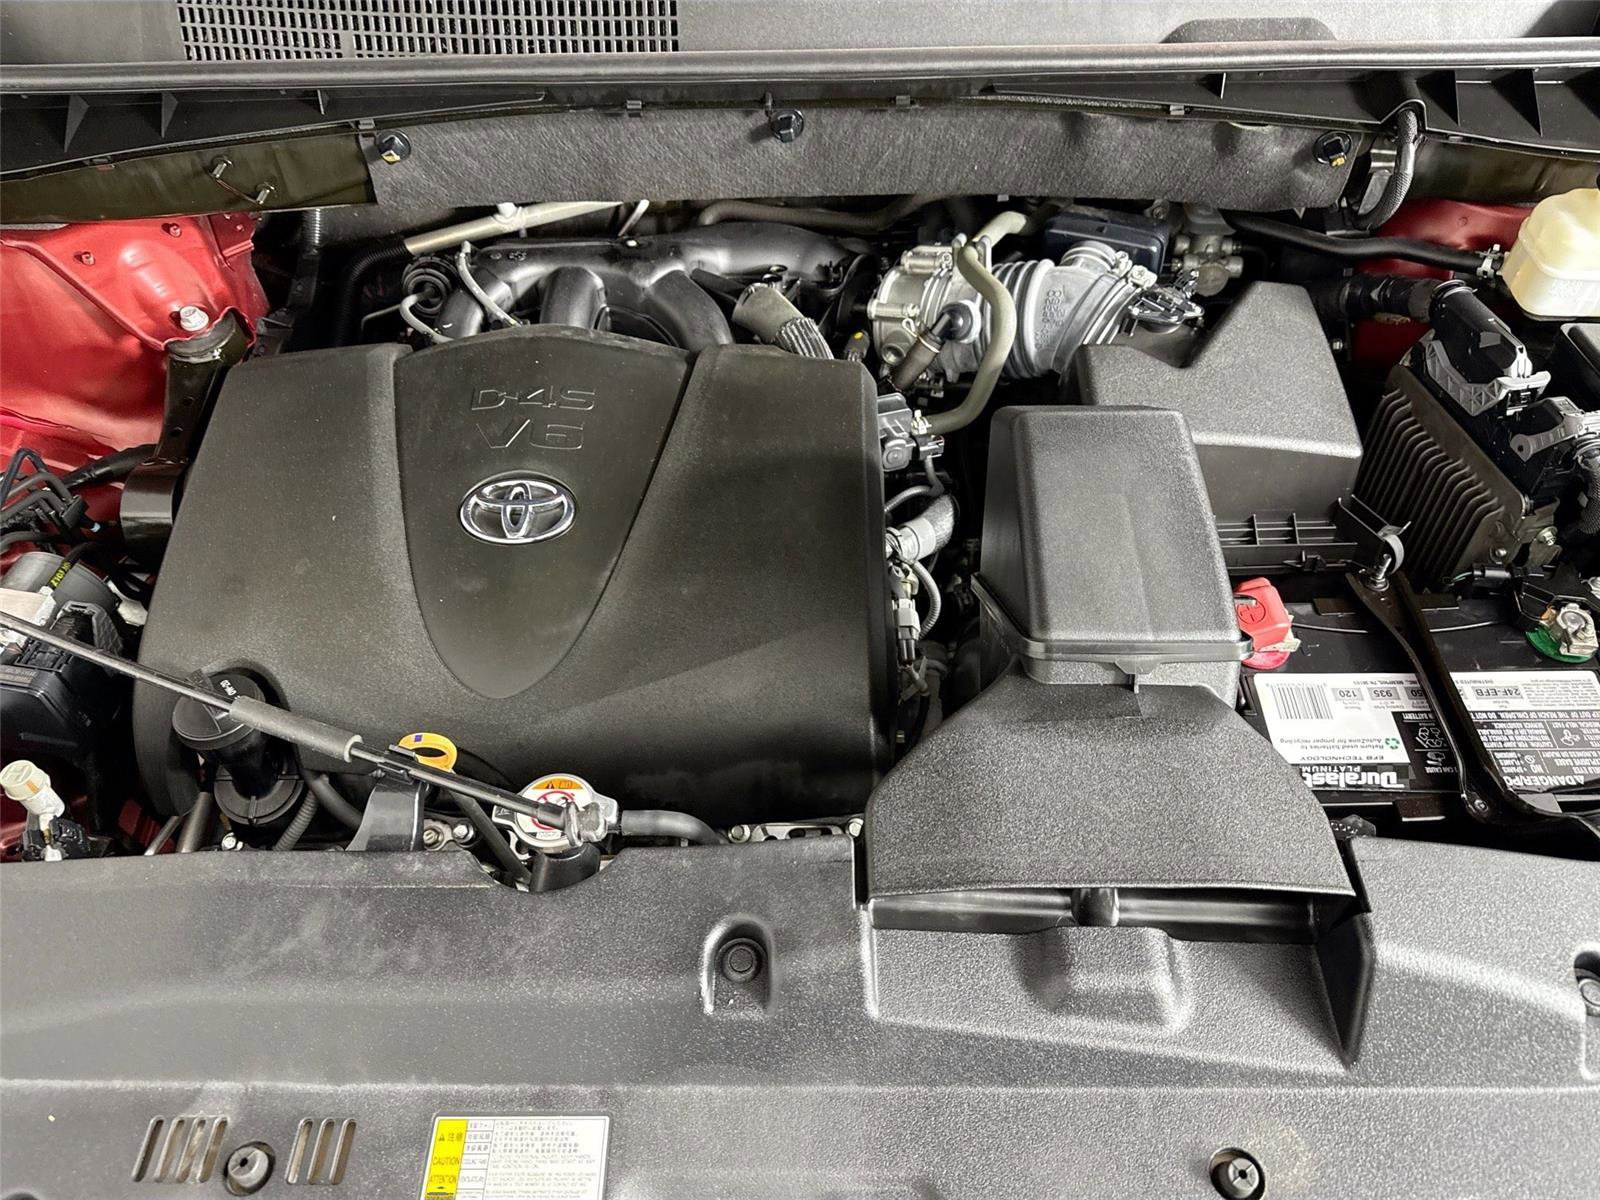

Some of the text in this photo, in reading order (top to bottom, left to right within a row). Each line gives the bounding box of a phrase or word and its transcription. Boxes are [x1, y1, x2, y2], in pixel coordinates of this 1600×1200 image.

[471, 385, 596, 411] D-4S
[475, 419, 585, 450] V6
[220, 679, 237, 696] 0W-20
[1475, 688, 1521, 697] 24F-EFB
[1338, 689, 1424, 698] 50 935 120
[1529, 764, 1544, 773] NO
[1301, 771, 1405, 788] Duralast
[1502, 775, 1577, 786] DANGER/PO
[432, 1156, 460, 1166] CAUTION
[429, 1174, 457, 1184] ATTENTION
